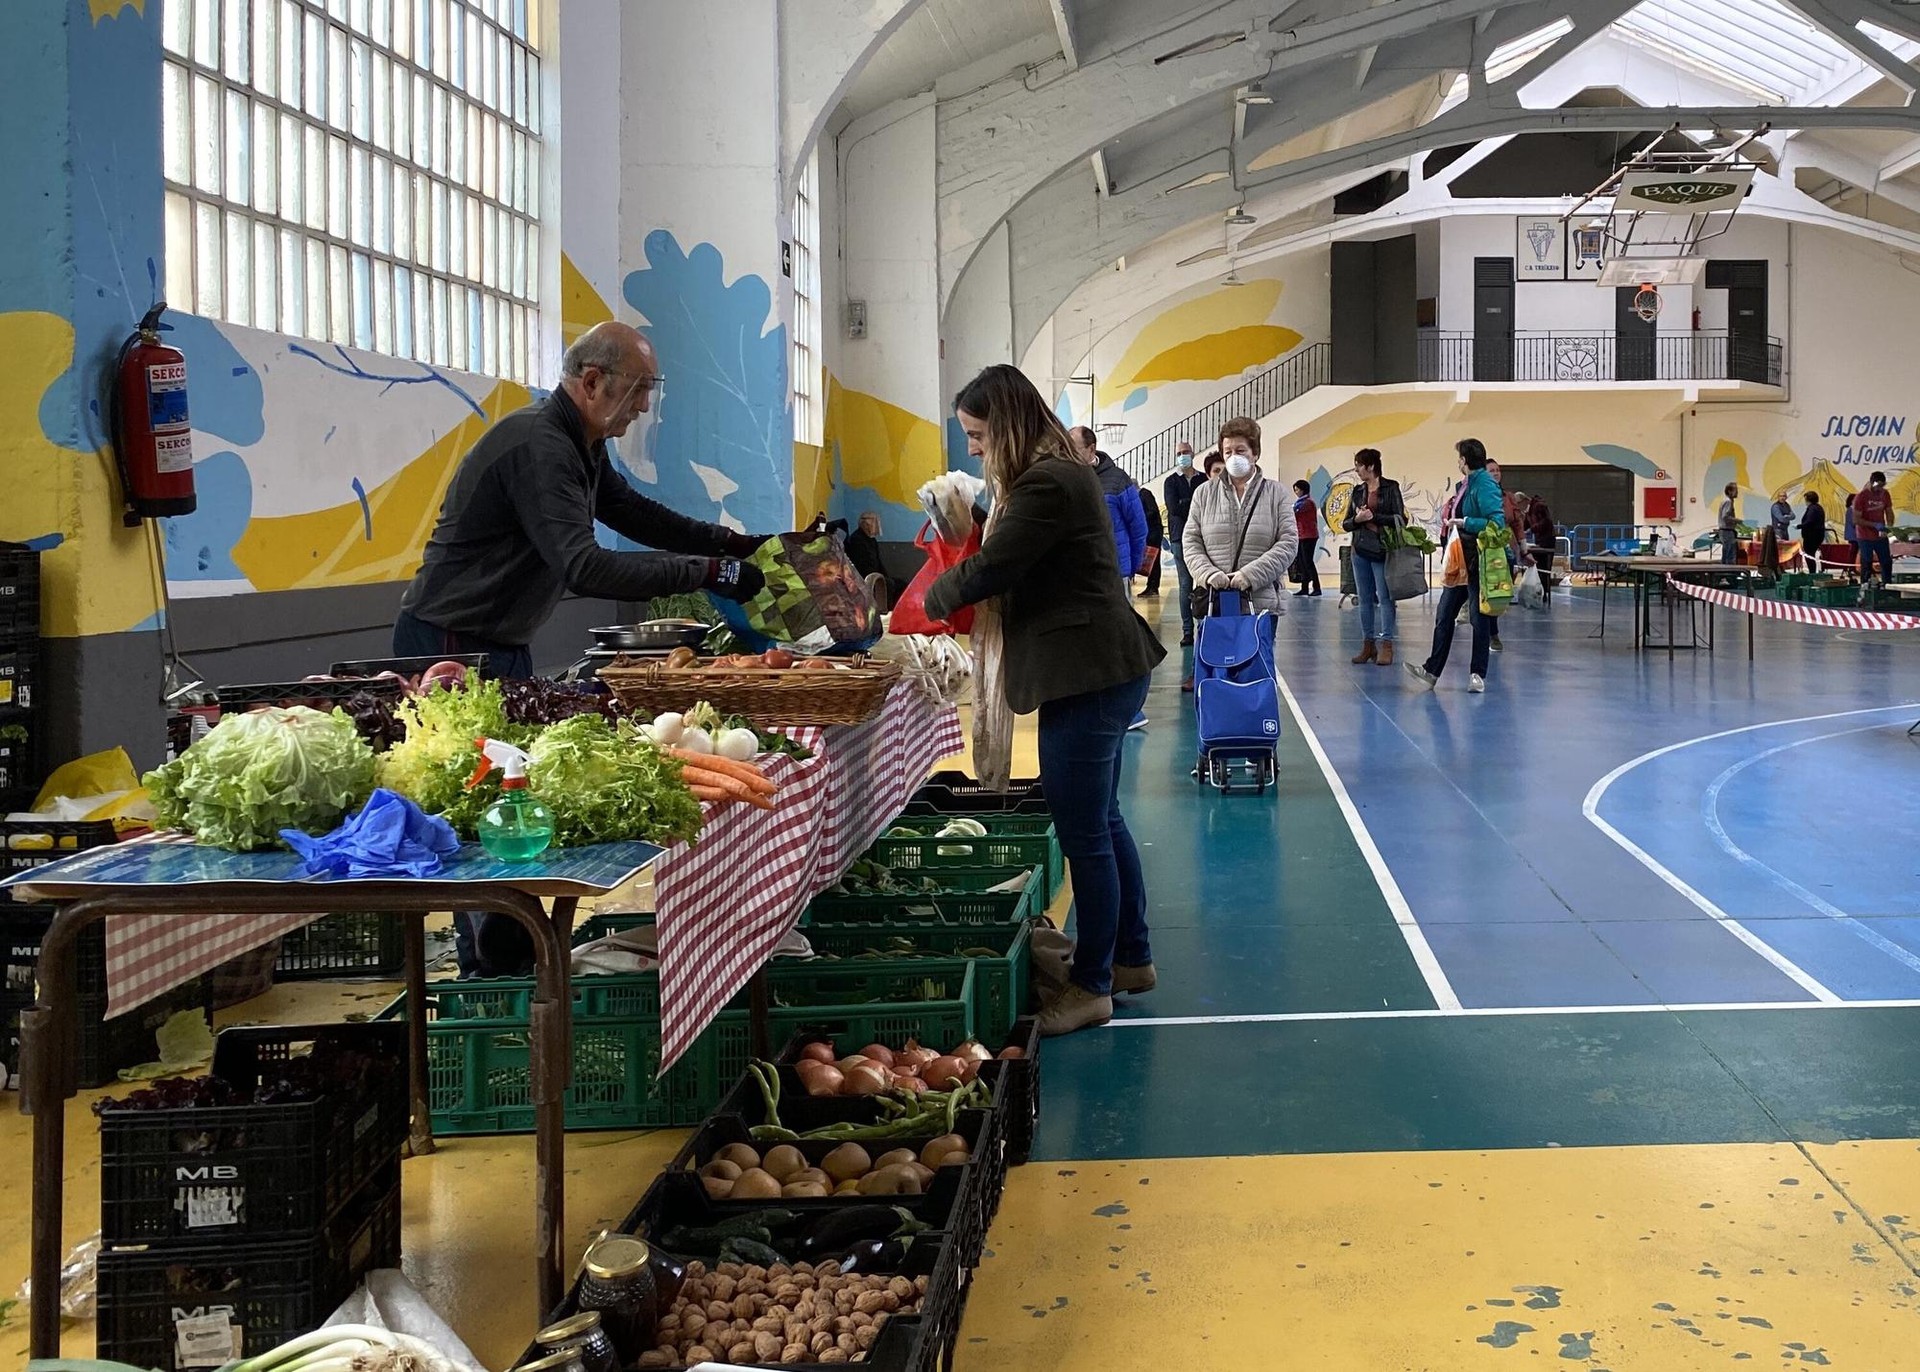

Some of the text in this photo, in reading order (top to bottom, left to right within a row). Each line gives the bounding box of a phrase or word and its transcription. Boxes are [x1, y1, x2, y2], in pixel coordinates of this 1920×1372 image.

[1644, 184, 1728, 196] BAQUÉ
[1821, 415, 1906, 437] SASOIAN
[176, 1165, 239, 1181] MB
